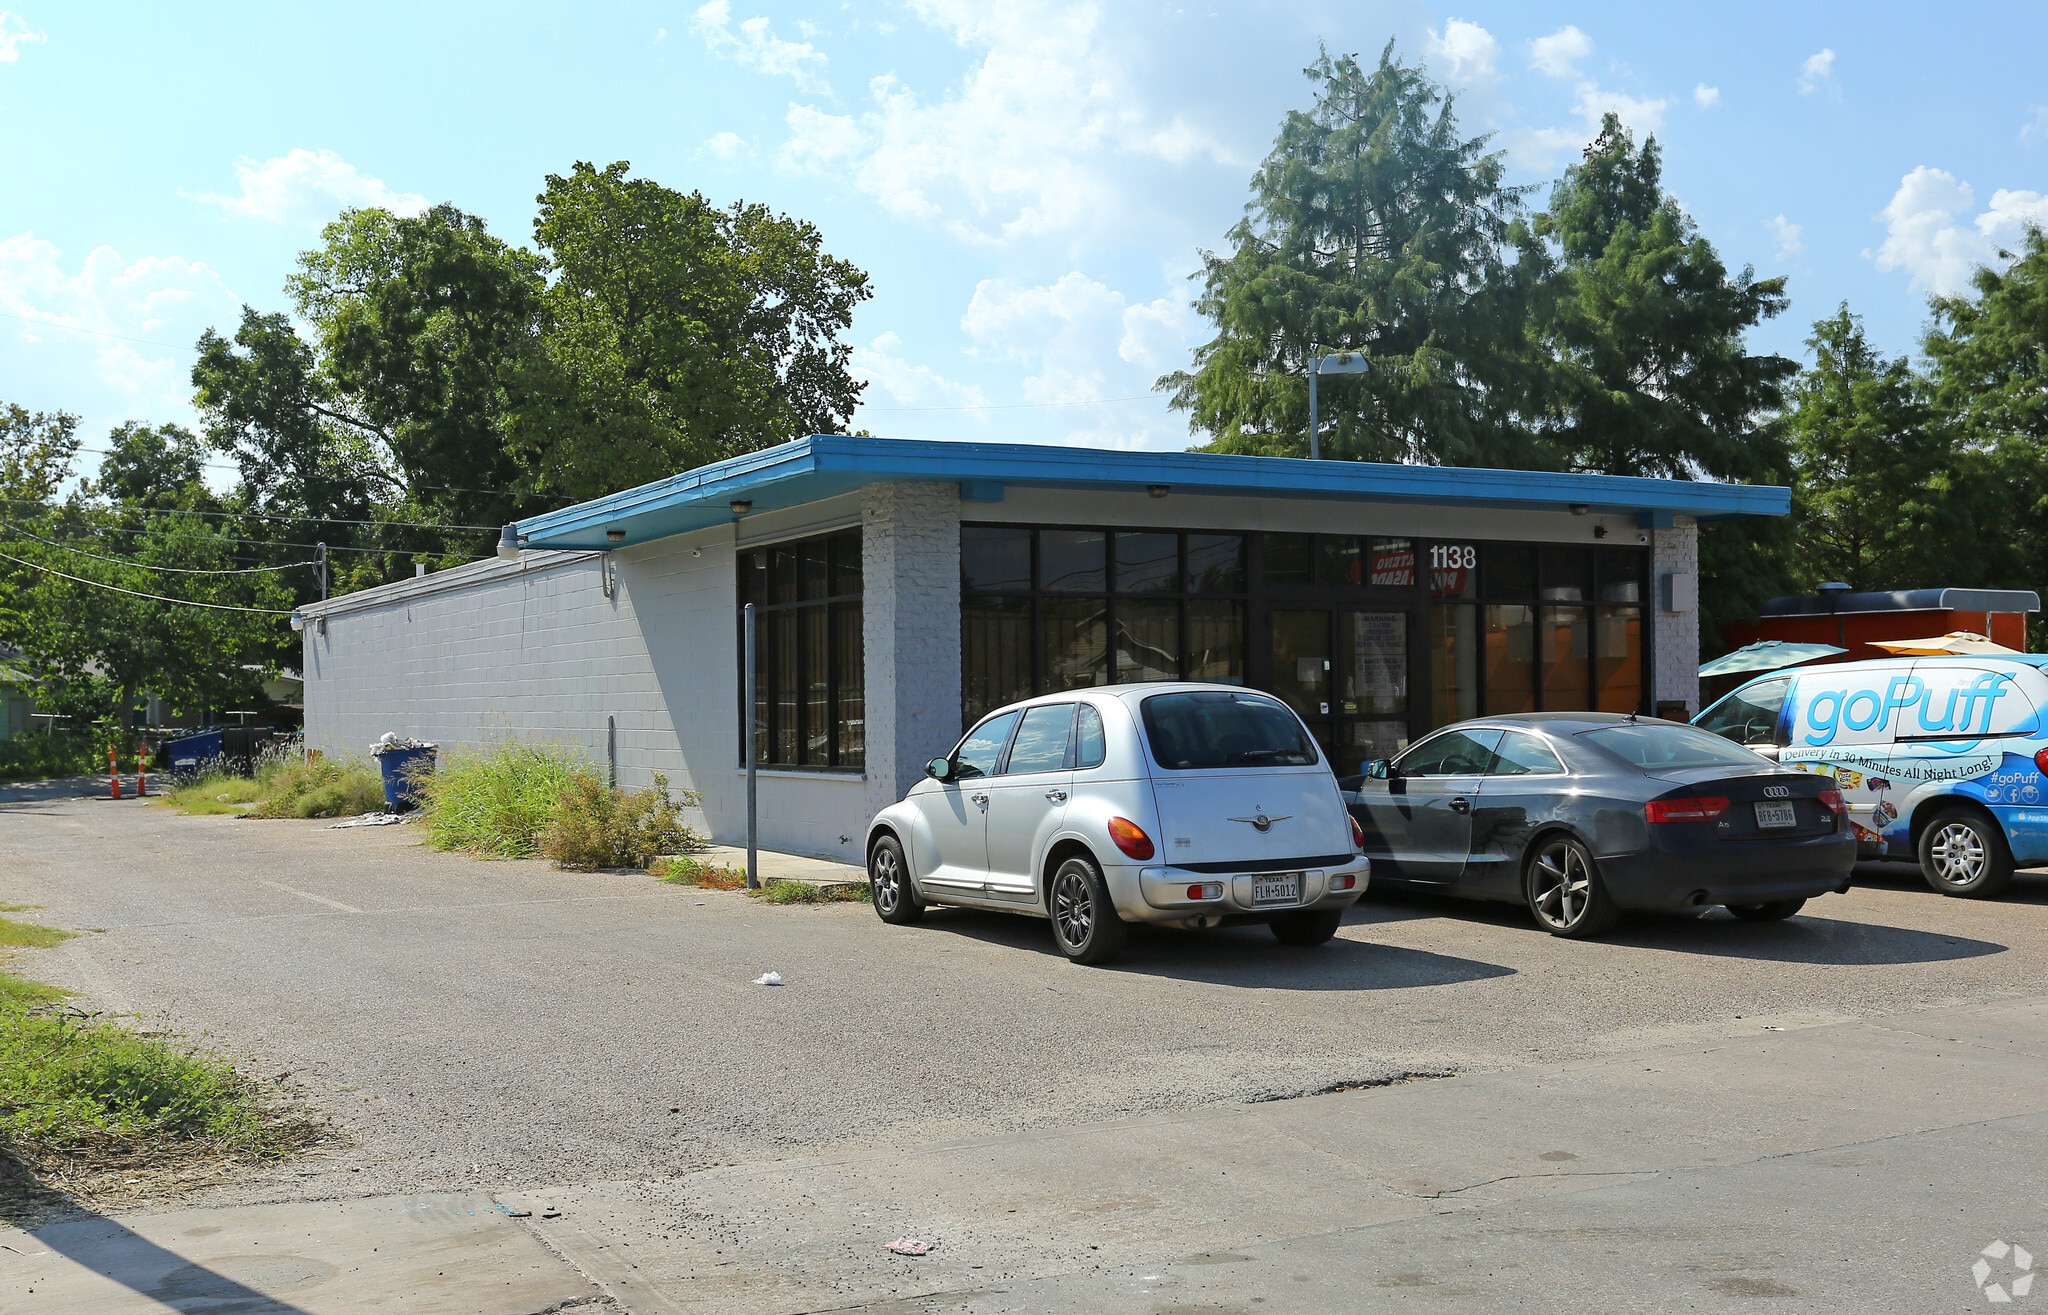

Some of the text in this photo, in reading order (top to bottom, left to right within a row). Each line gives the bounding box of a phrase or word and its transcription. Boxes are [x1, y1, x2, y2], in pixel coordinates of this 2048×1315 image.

[1430, 545, 1477, 569] 1138
[1804, 671, 2018, 753] goPuff
[1784, 748, 1993, 783] Delivery In 30 Minutes All Night Long!
[1990, 772, 2040, 787] #goPuff
